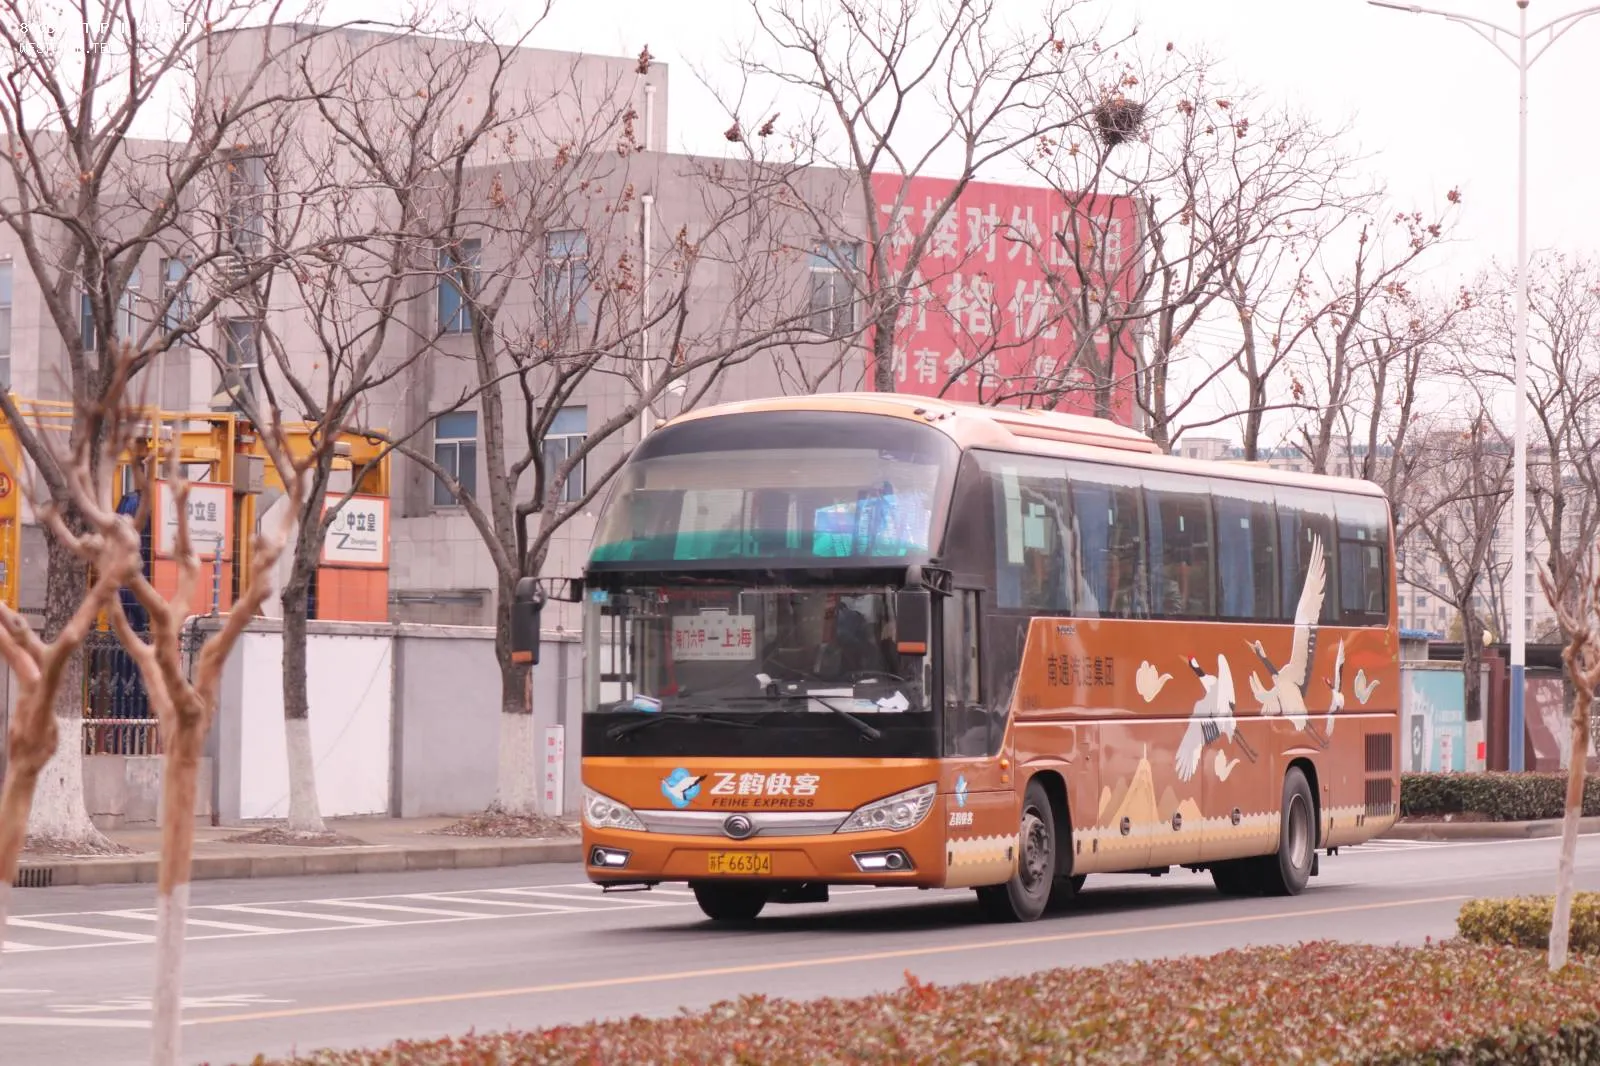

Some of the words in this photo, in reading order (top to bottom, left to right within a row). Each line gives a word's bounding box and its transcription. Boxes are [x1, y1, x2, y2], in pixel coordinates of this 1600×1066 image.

[880, 195, 1121, 272] 本楼对外出租
[346, 511, 376, 532] 中立皇
[709, 772, 821, 796] 飞鹤快客
[712, 797, 750, 808] FEIHE
[753, 797, 815, 808] EXPRESS
